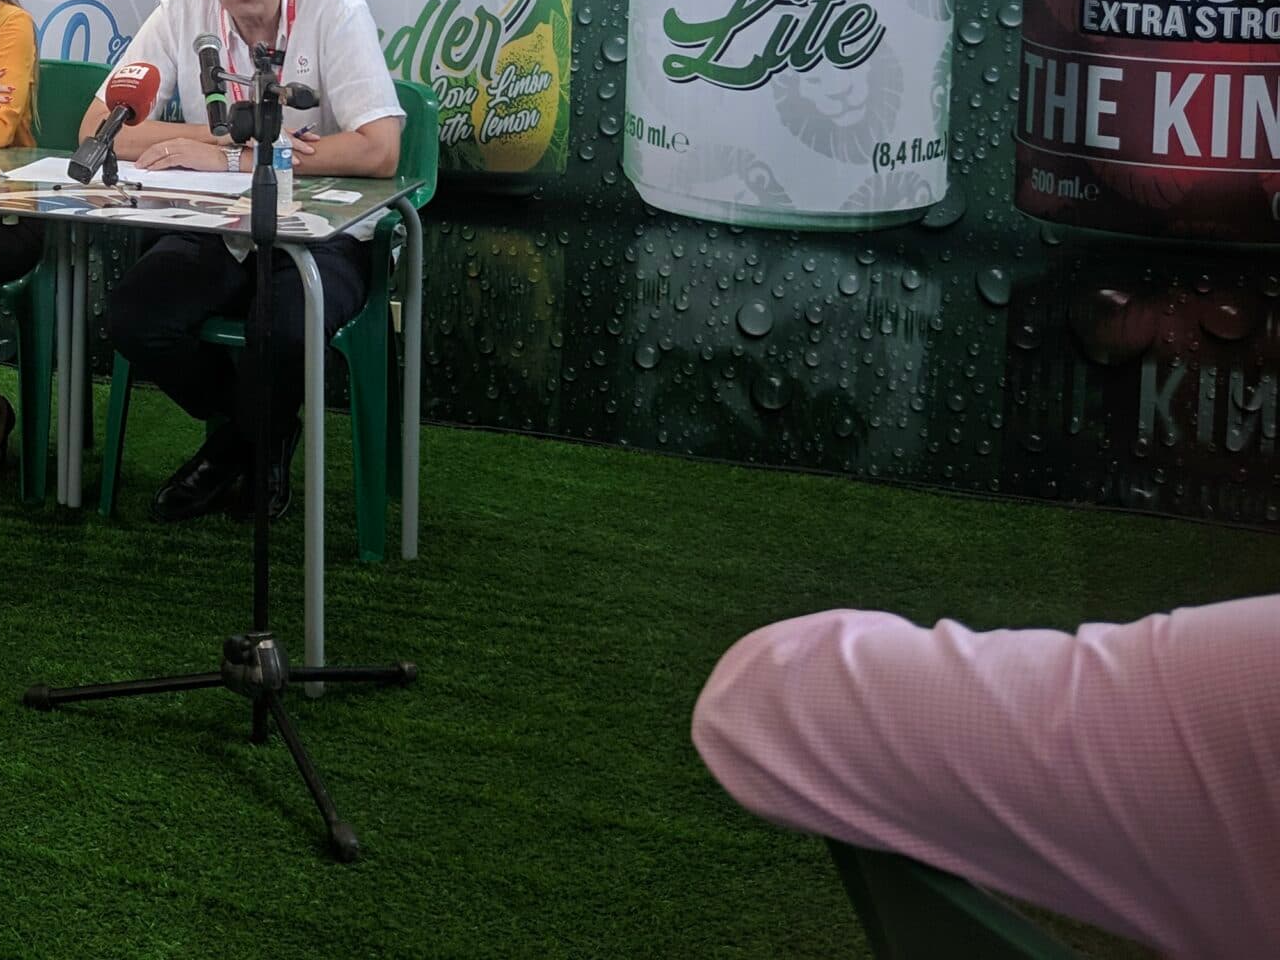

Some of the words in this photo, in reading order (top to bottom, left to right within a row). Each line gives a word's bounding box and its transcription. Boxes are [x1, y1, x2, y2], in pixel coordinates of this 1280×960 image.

[432, 76, 477, 110] Con
[488, 64, 551, 108] Limón
[1024, 50, 1124, 151] THE
[1152, 71, 1280, 160] KIN
[439, 114, 473, 146] ith
[481, 110, 541, 143] lemon
[872, 141, 908, 173] (8,4
[1031, 167, 1055, 195] 500
